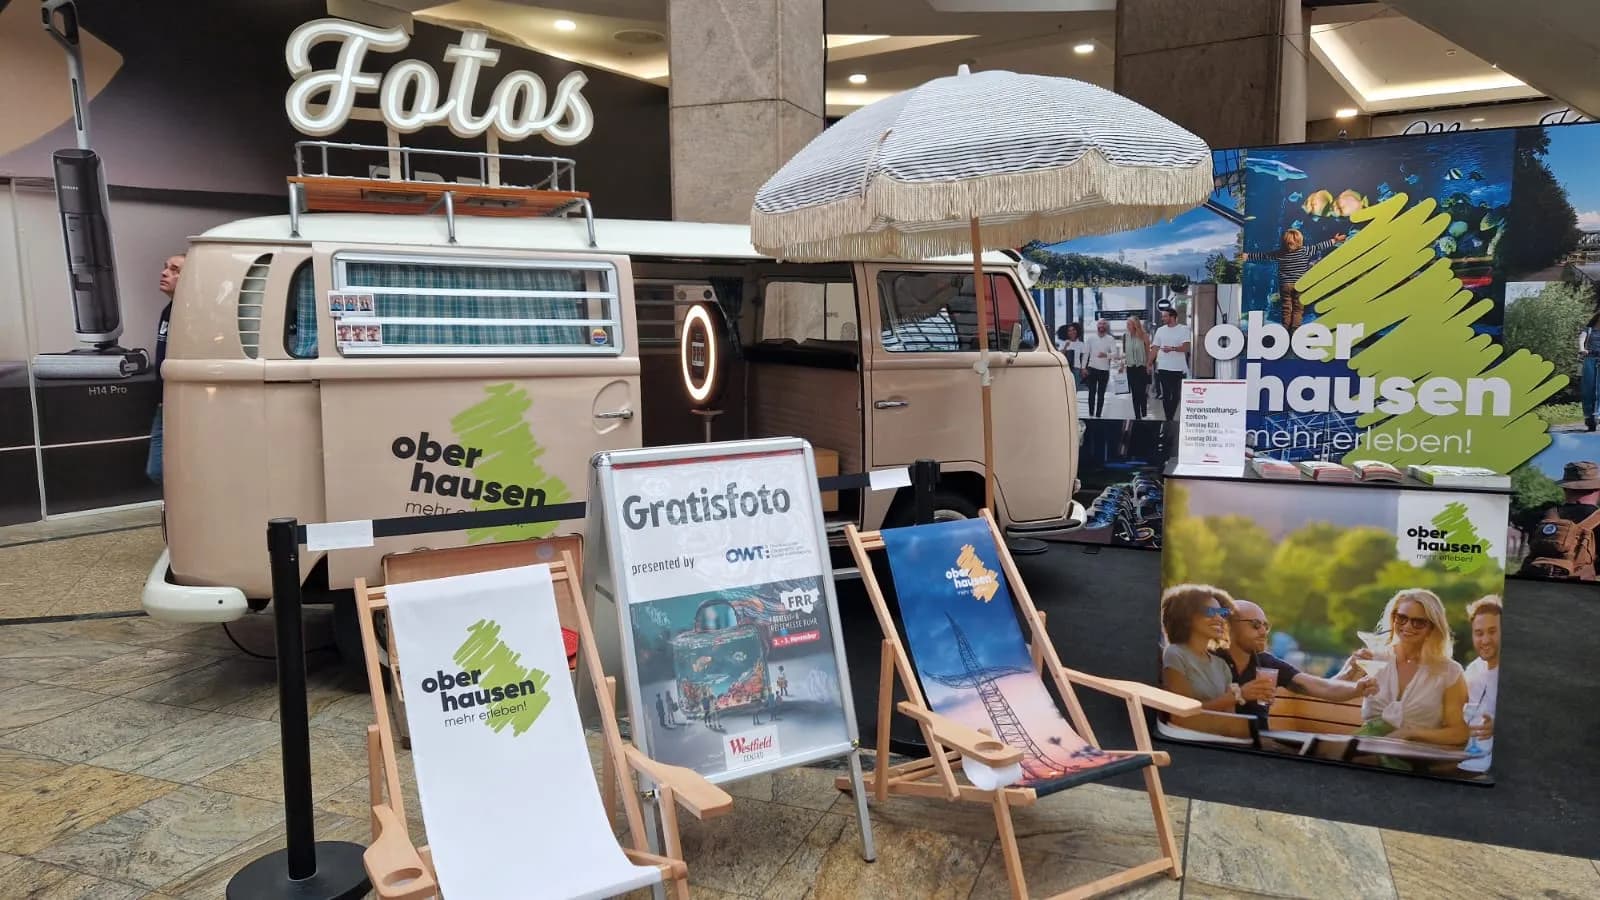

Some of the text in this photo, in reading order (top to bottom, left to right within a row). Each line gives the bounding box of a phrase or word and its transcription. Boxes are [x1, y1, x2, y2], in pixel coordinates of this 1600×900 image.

[285, 17, 594, 146] Fotos
[1204, 310, 1364, 361] ober
[88, 385, 128, 396] H14 Pro
[1246, 362, 1511, 416] hausen
[391, 432, 483, 469] ober
[1246, 425, 1472, 455] mehr erleben!
[410, 463, 546, 509] hausen
[622, 482, 791, 531] Gratisfoto
[1407, 525, 1448, 539] ober
[1417, 538, 1482, 554] hausen
[631, 556, 695, 576] presented by
[788, 594, 814, 608] FRR
[421, 668, 482, 693] ober
[440, 679, 536, 712] hausen
[444, 701, 528, 728] mehr erleben!
[730, 736, 772, 756] Westfield
